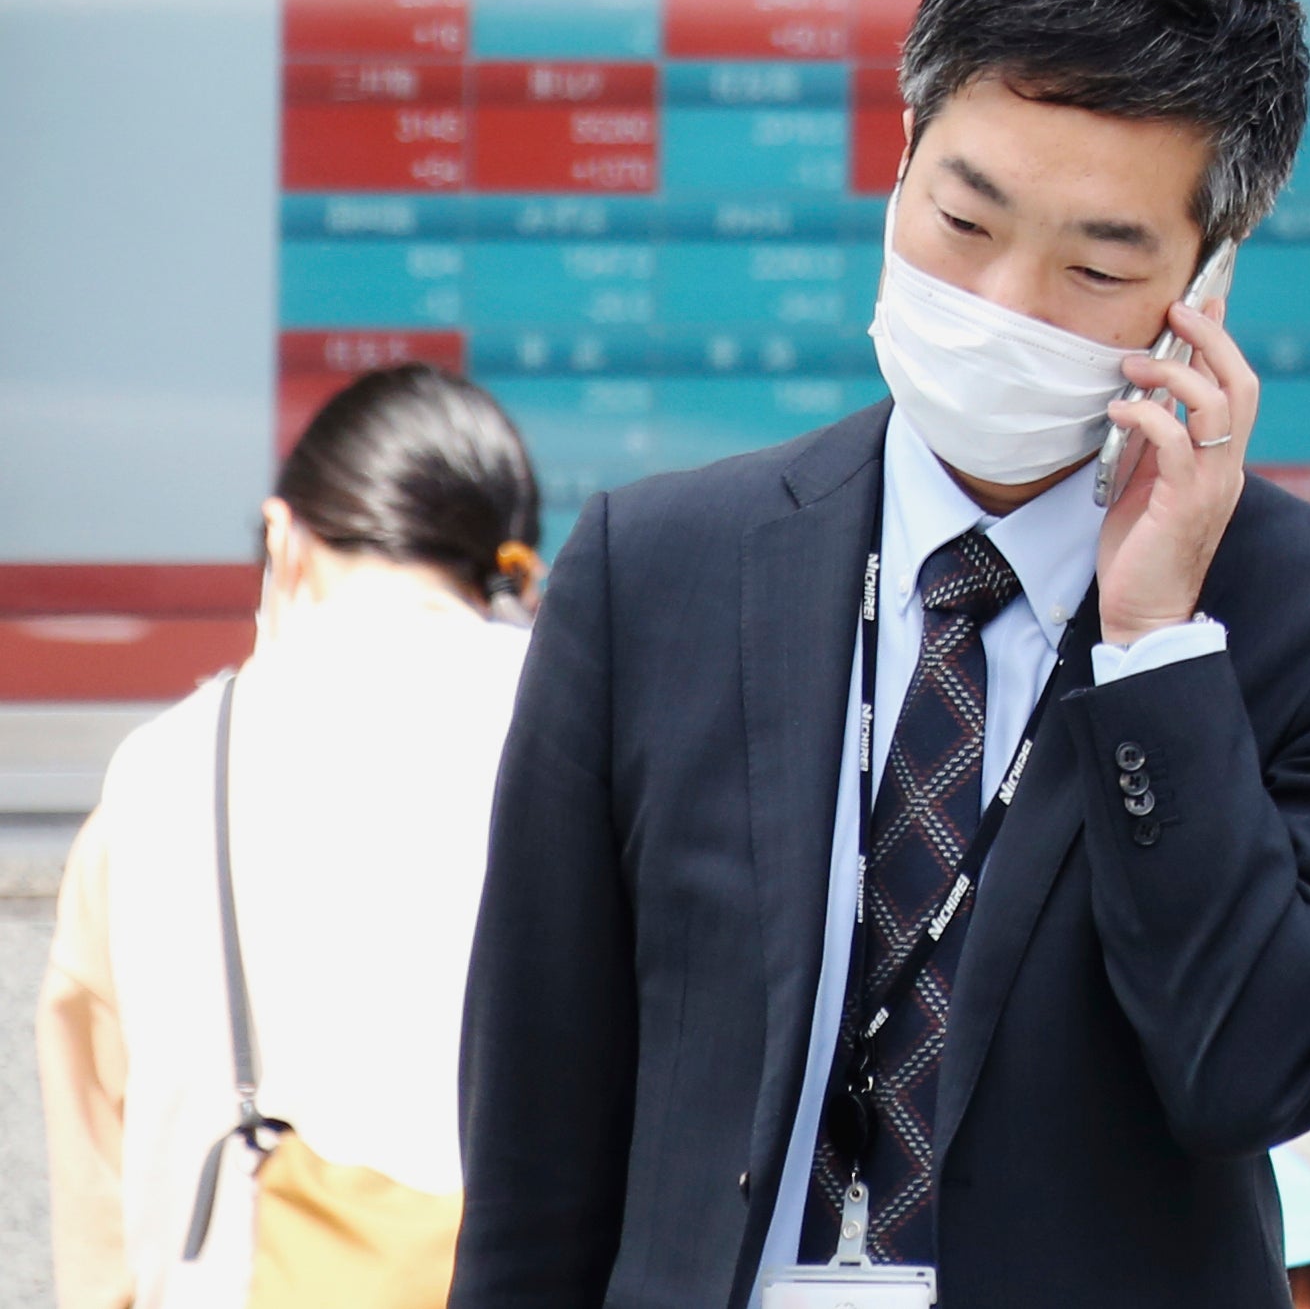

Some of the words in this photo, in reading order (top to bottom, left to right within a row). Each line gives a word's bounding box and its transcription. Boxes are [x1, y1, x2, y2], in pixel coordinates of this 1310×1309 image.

[863, 553, 879, 621] NICHIREI
[860, 703, 873, 772] NICHIREI
[998, 738, 1034, 806] NICHIREI
[927, 873, 970, 942] NICHIREI
